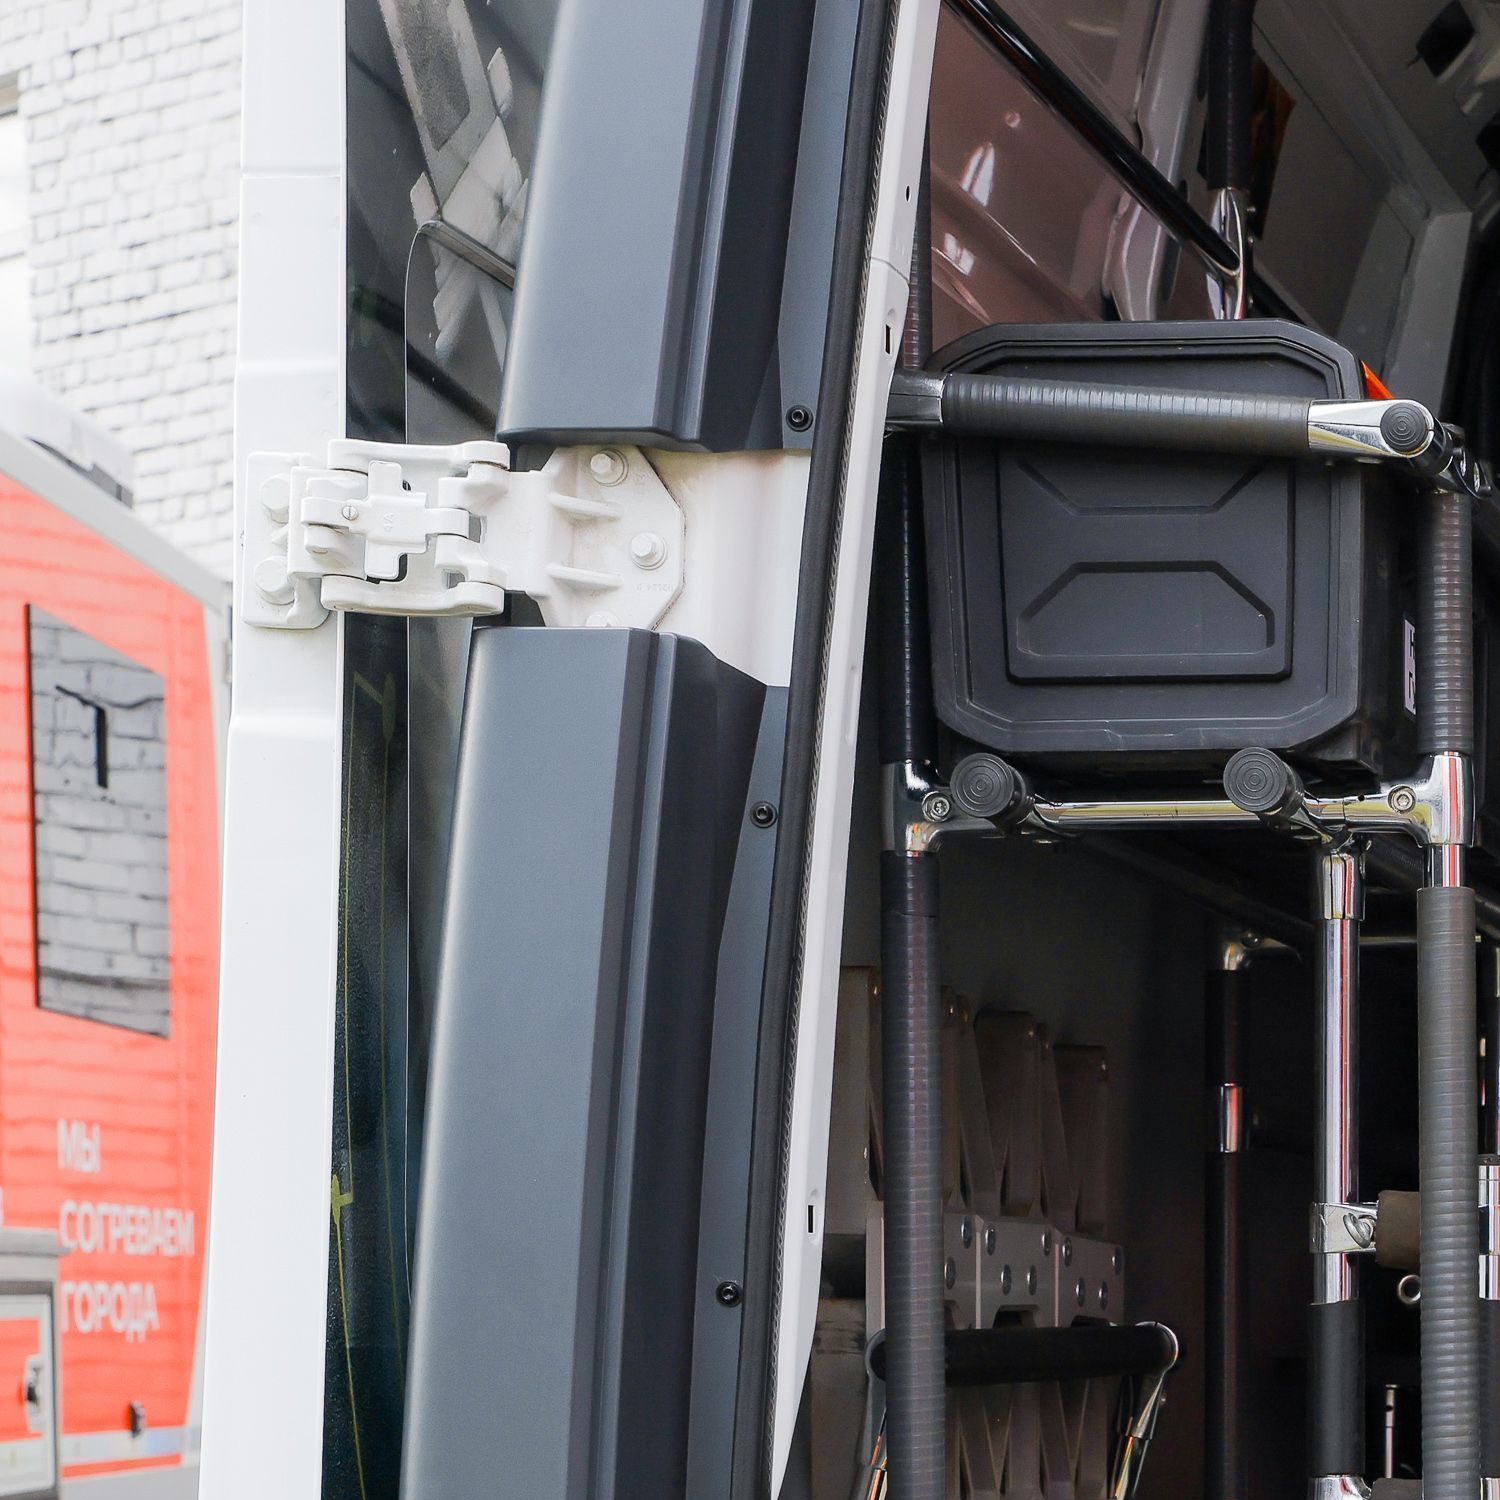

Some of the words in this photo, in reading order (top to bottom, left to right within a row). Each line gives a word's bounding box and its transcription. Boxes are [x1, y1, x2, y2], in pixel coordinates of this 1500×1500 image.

[57, 1118, 102, 1172] МЫ
[59, 1200, 195, 1257] СОГРЕВАЕМ
[60, 1281, 160, 1342] ГОРОДА
